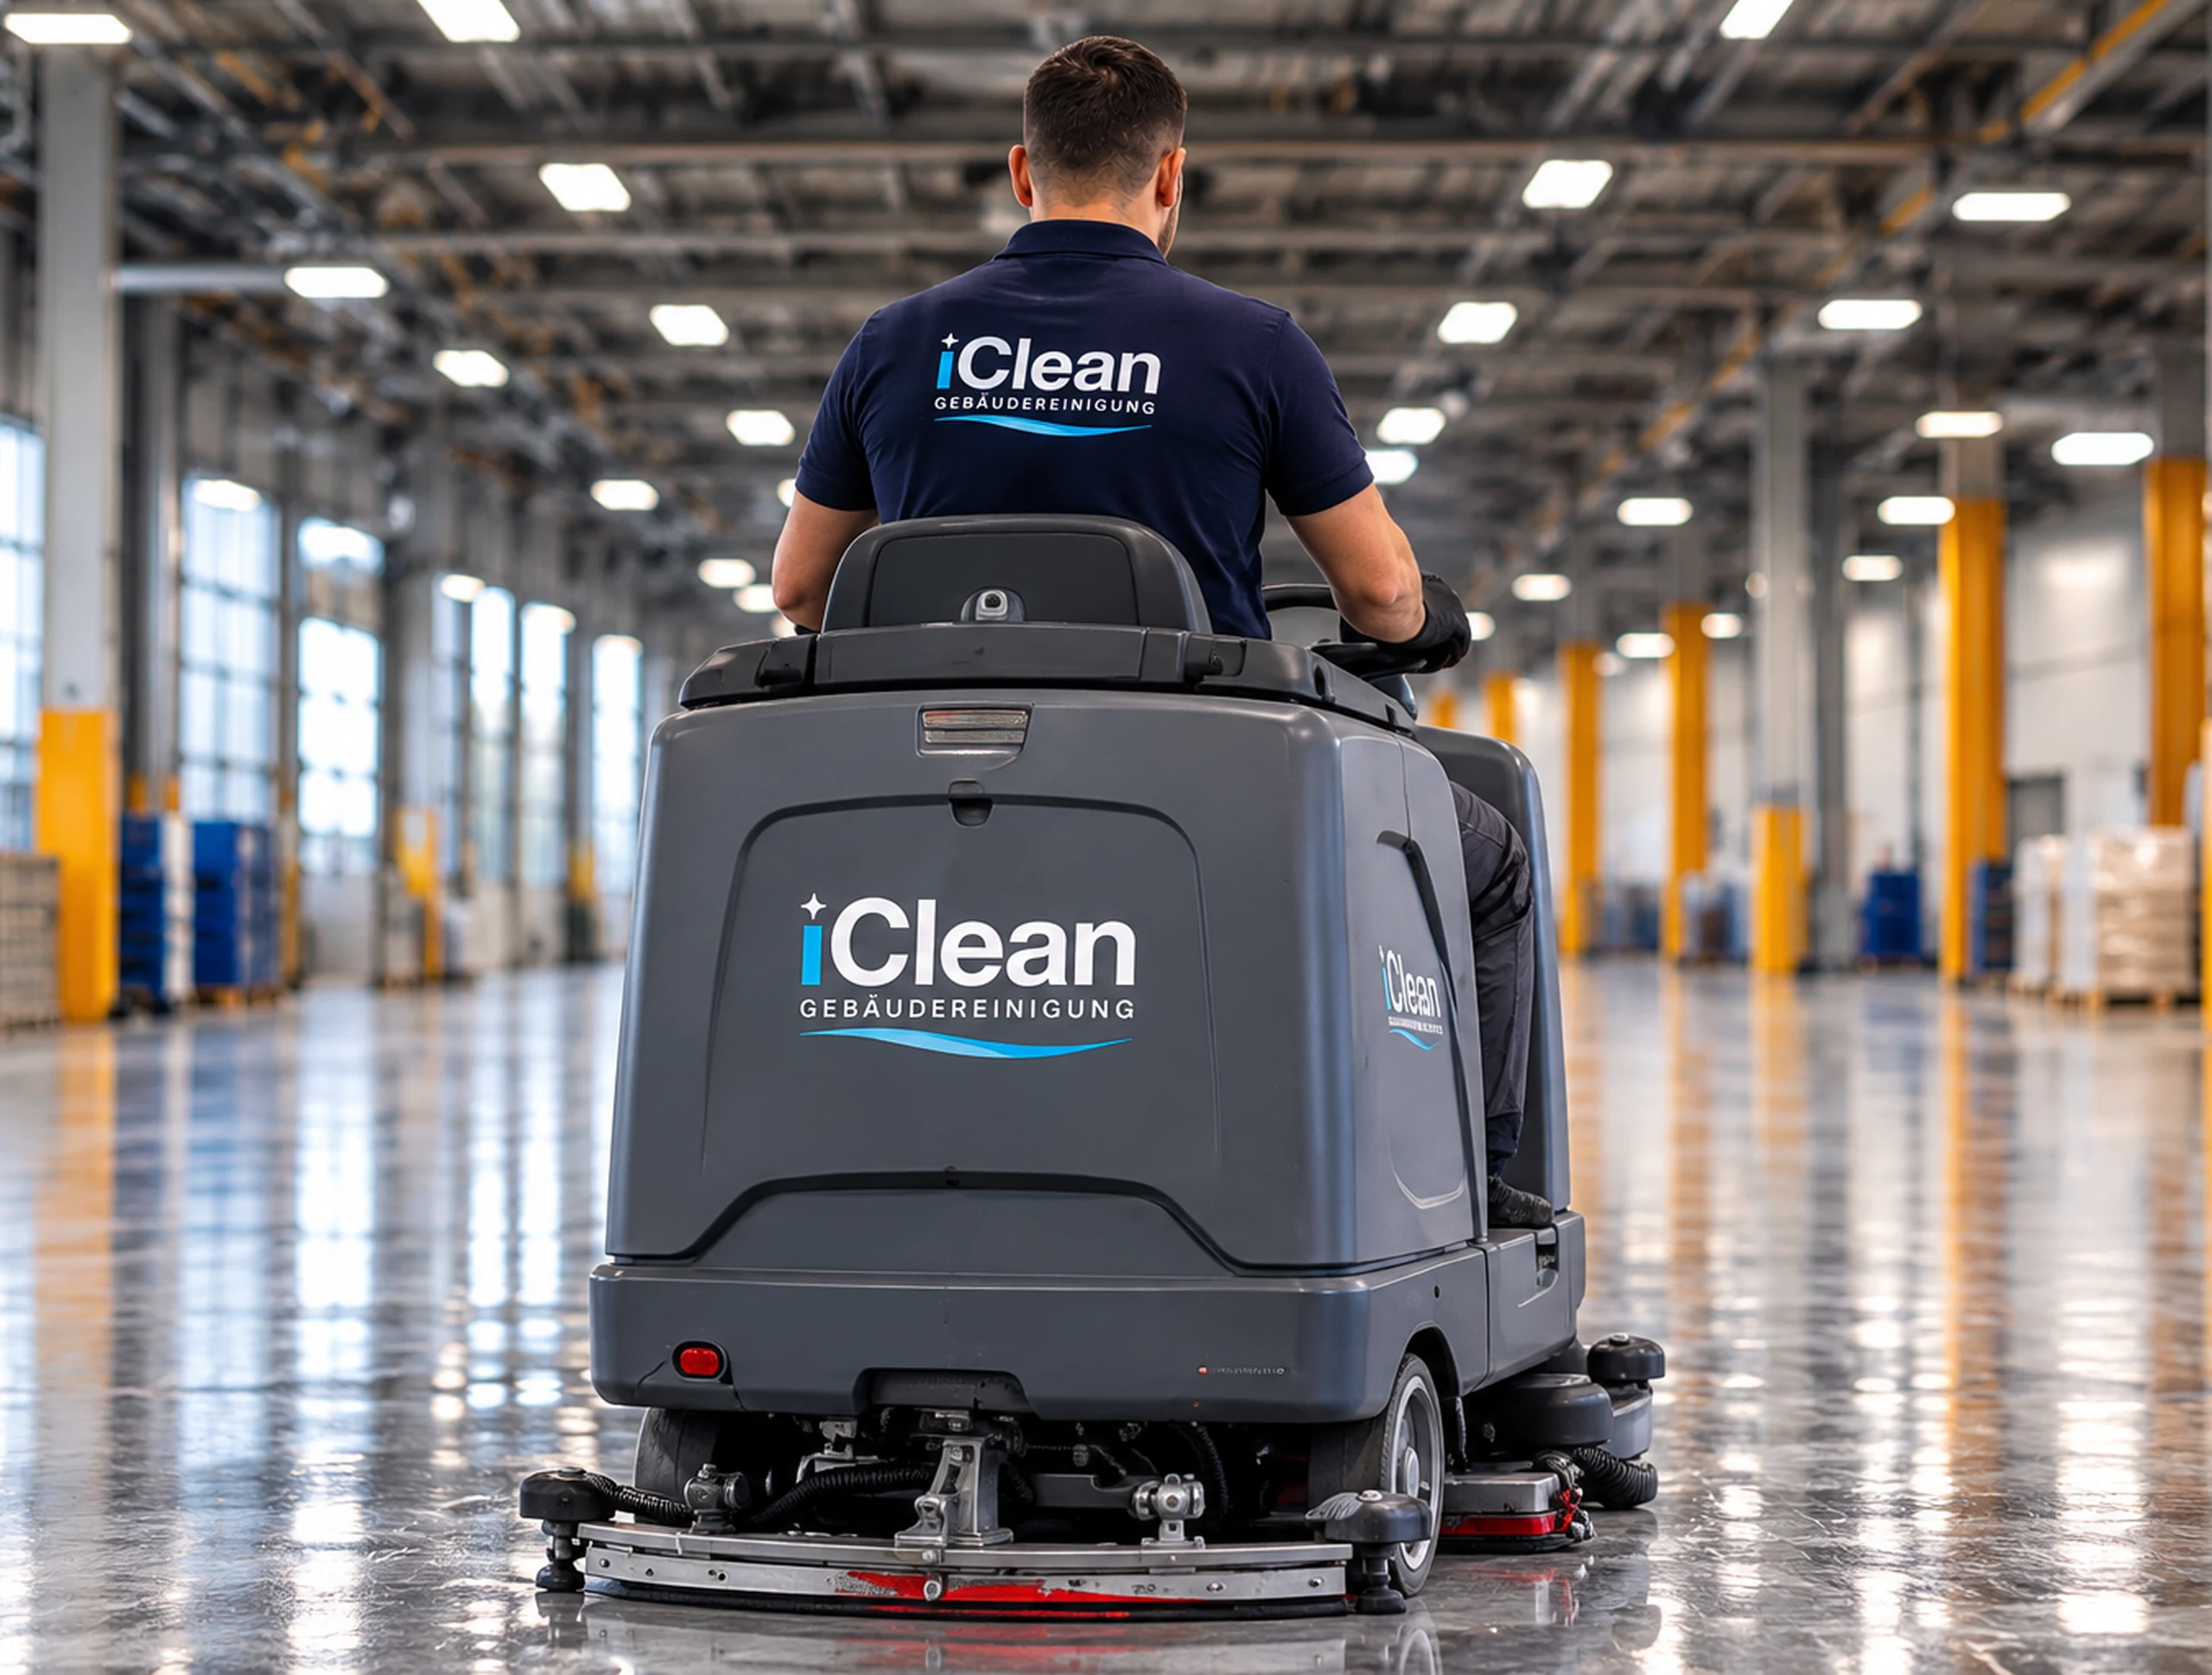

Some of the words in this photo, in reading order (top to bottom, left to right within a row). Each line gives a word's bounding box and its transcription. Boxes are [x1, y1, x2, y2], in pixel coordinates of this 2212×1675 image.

[937, 333, 1161, 394] iClean
[934, 392, 1155, 415] GEBÄUDEREINIGUNG
[800, 892, 1136, 987] iClean
[800, 994, 1135, 1018] GEBÄUDEREINIGUNG
[1379, 945, 1441, 1018] iClean
